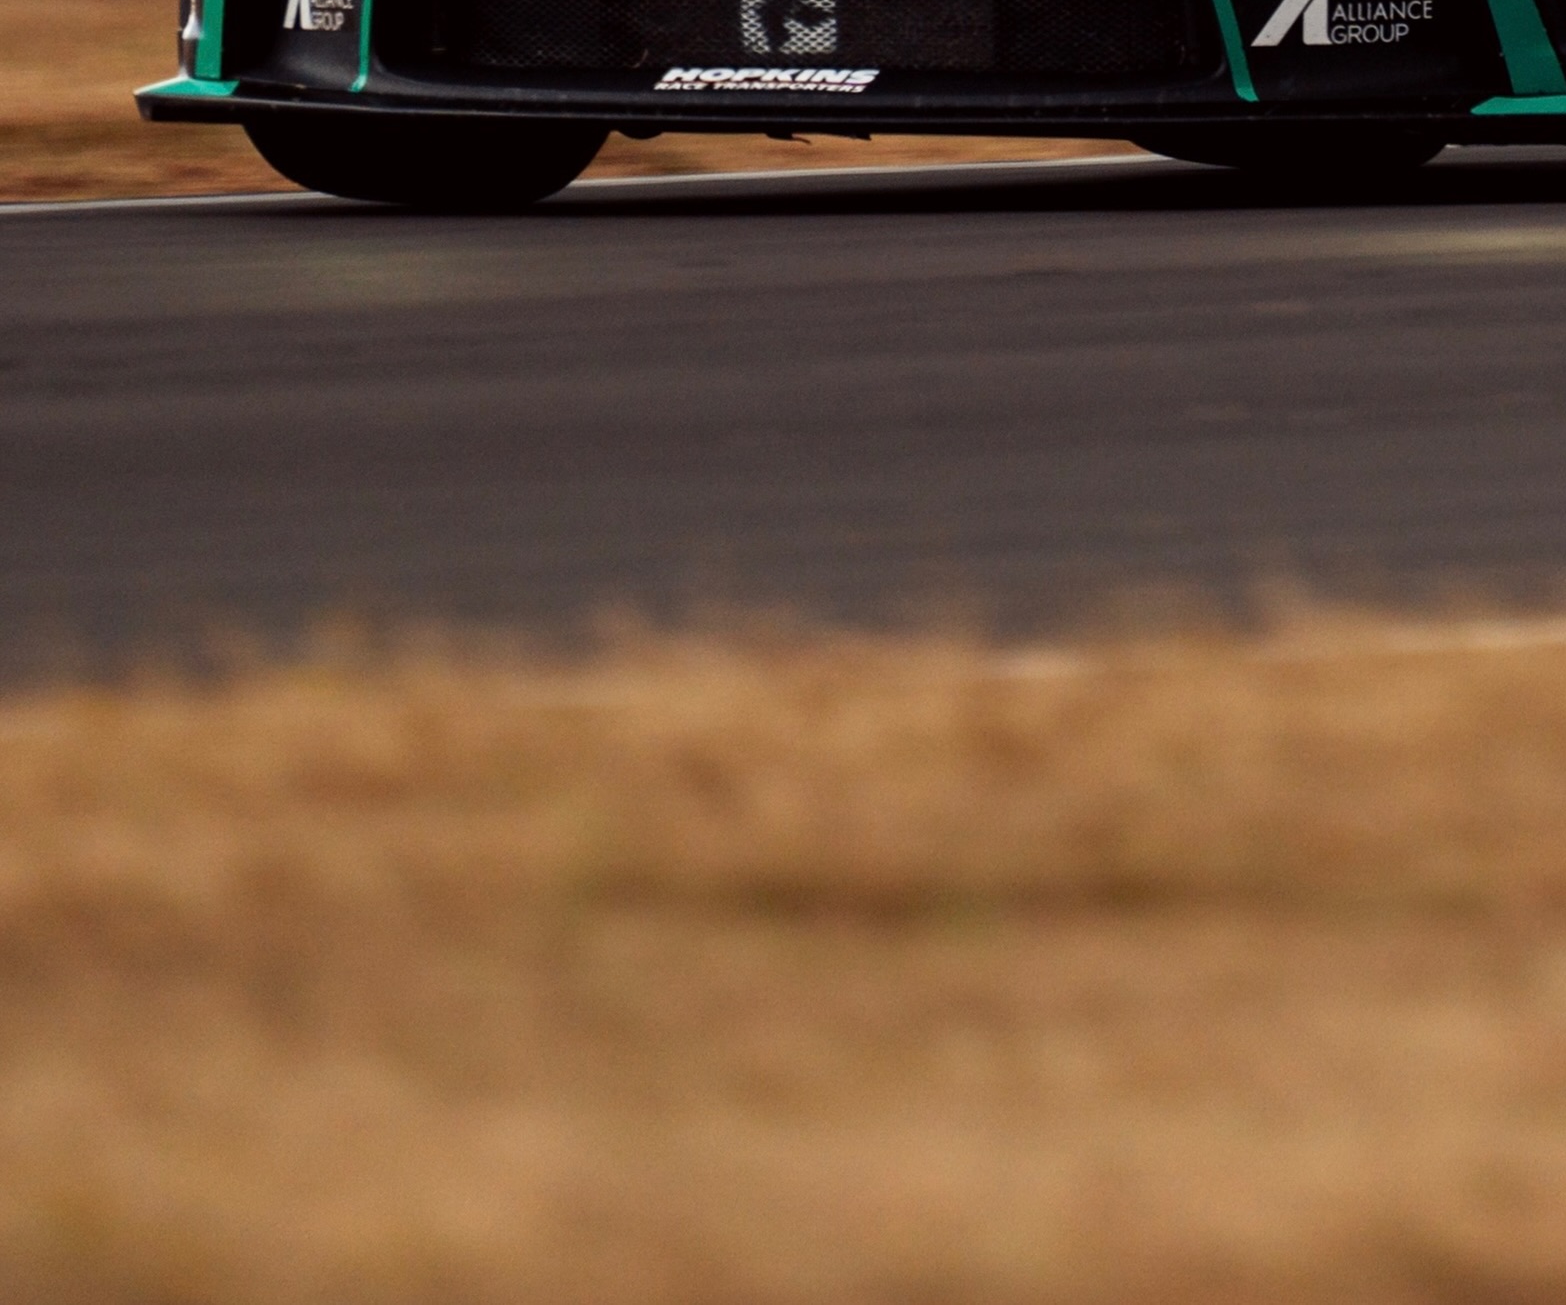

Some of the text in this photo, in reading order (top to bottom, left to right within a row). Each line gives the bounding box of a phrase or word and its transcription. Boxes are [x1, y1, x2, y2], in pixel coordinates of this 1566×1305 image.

[1332, 0, 1433, 22] ALLIANCE
[1331, 23, 1409, 44] GROUP
[662, 67, 880, 85] HOPKINS
[653, 81, 867, 93] RACE TRANSPORTERS
